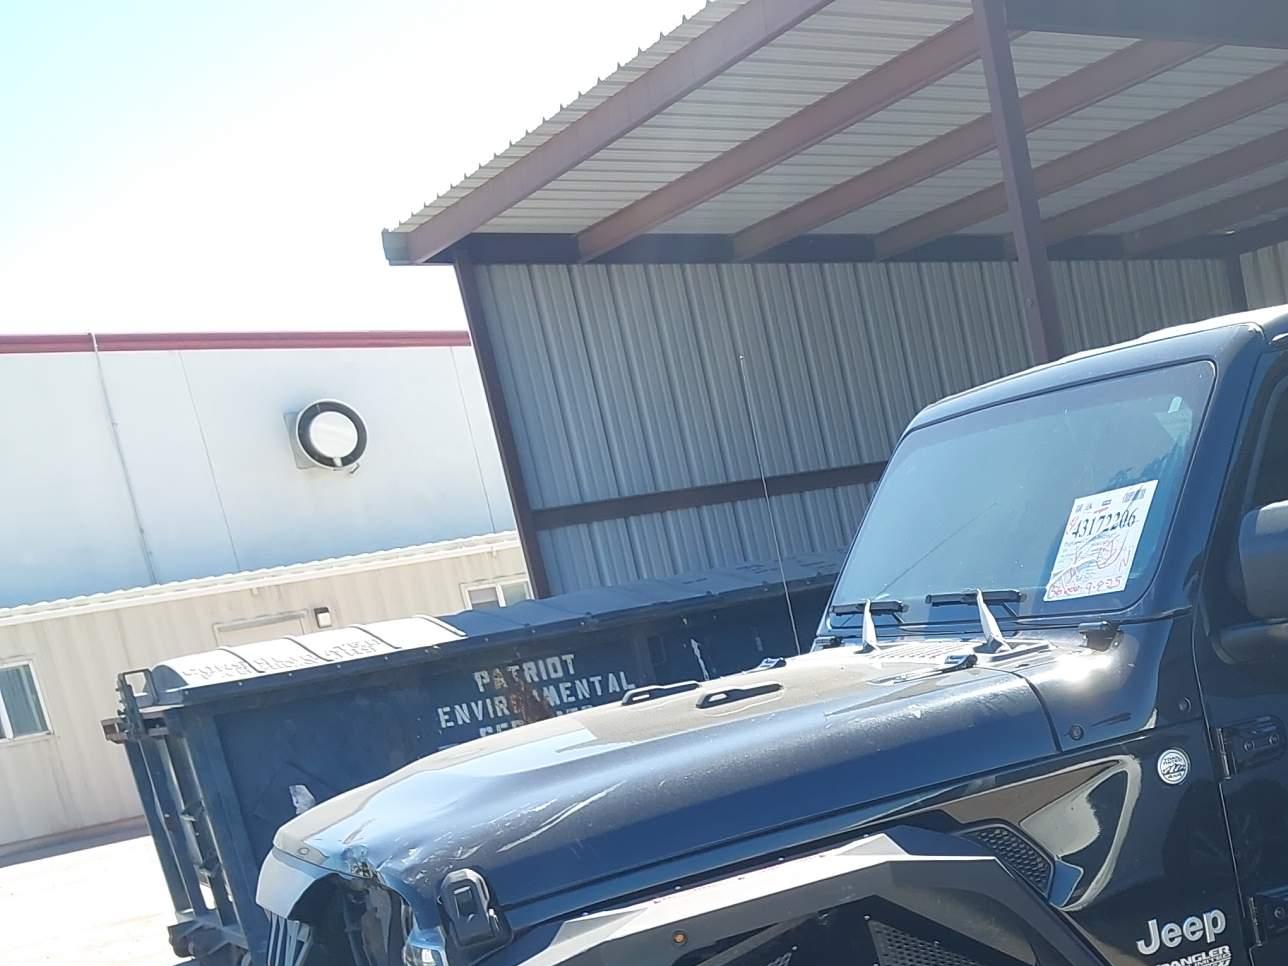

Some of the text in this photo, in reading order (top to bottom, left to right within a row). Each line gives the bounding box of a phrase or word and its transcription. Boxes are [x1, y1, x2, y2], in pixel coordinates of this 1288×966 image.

[1072, 508, 1138, 538] 43172206
[473, 654, 575, 692] PATRIOT
[437, 671, 636, 729] ENVIRMENTAL
[1136, 909, 1226, 956] Jeep
